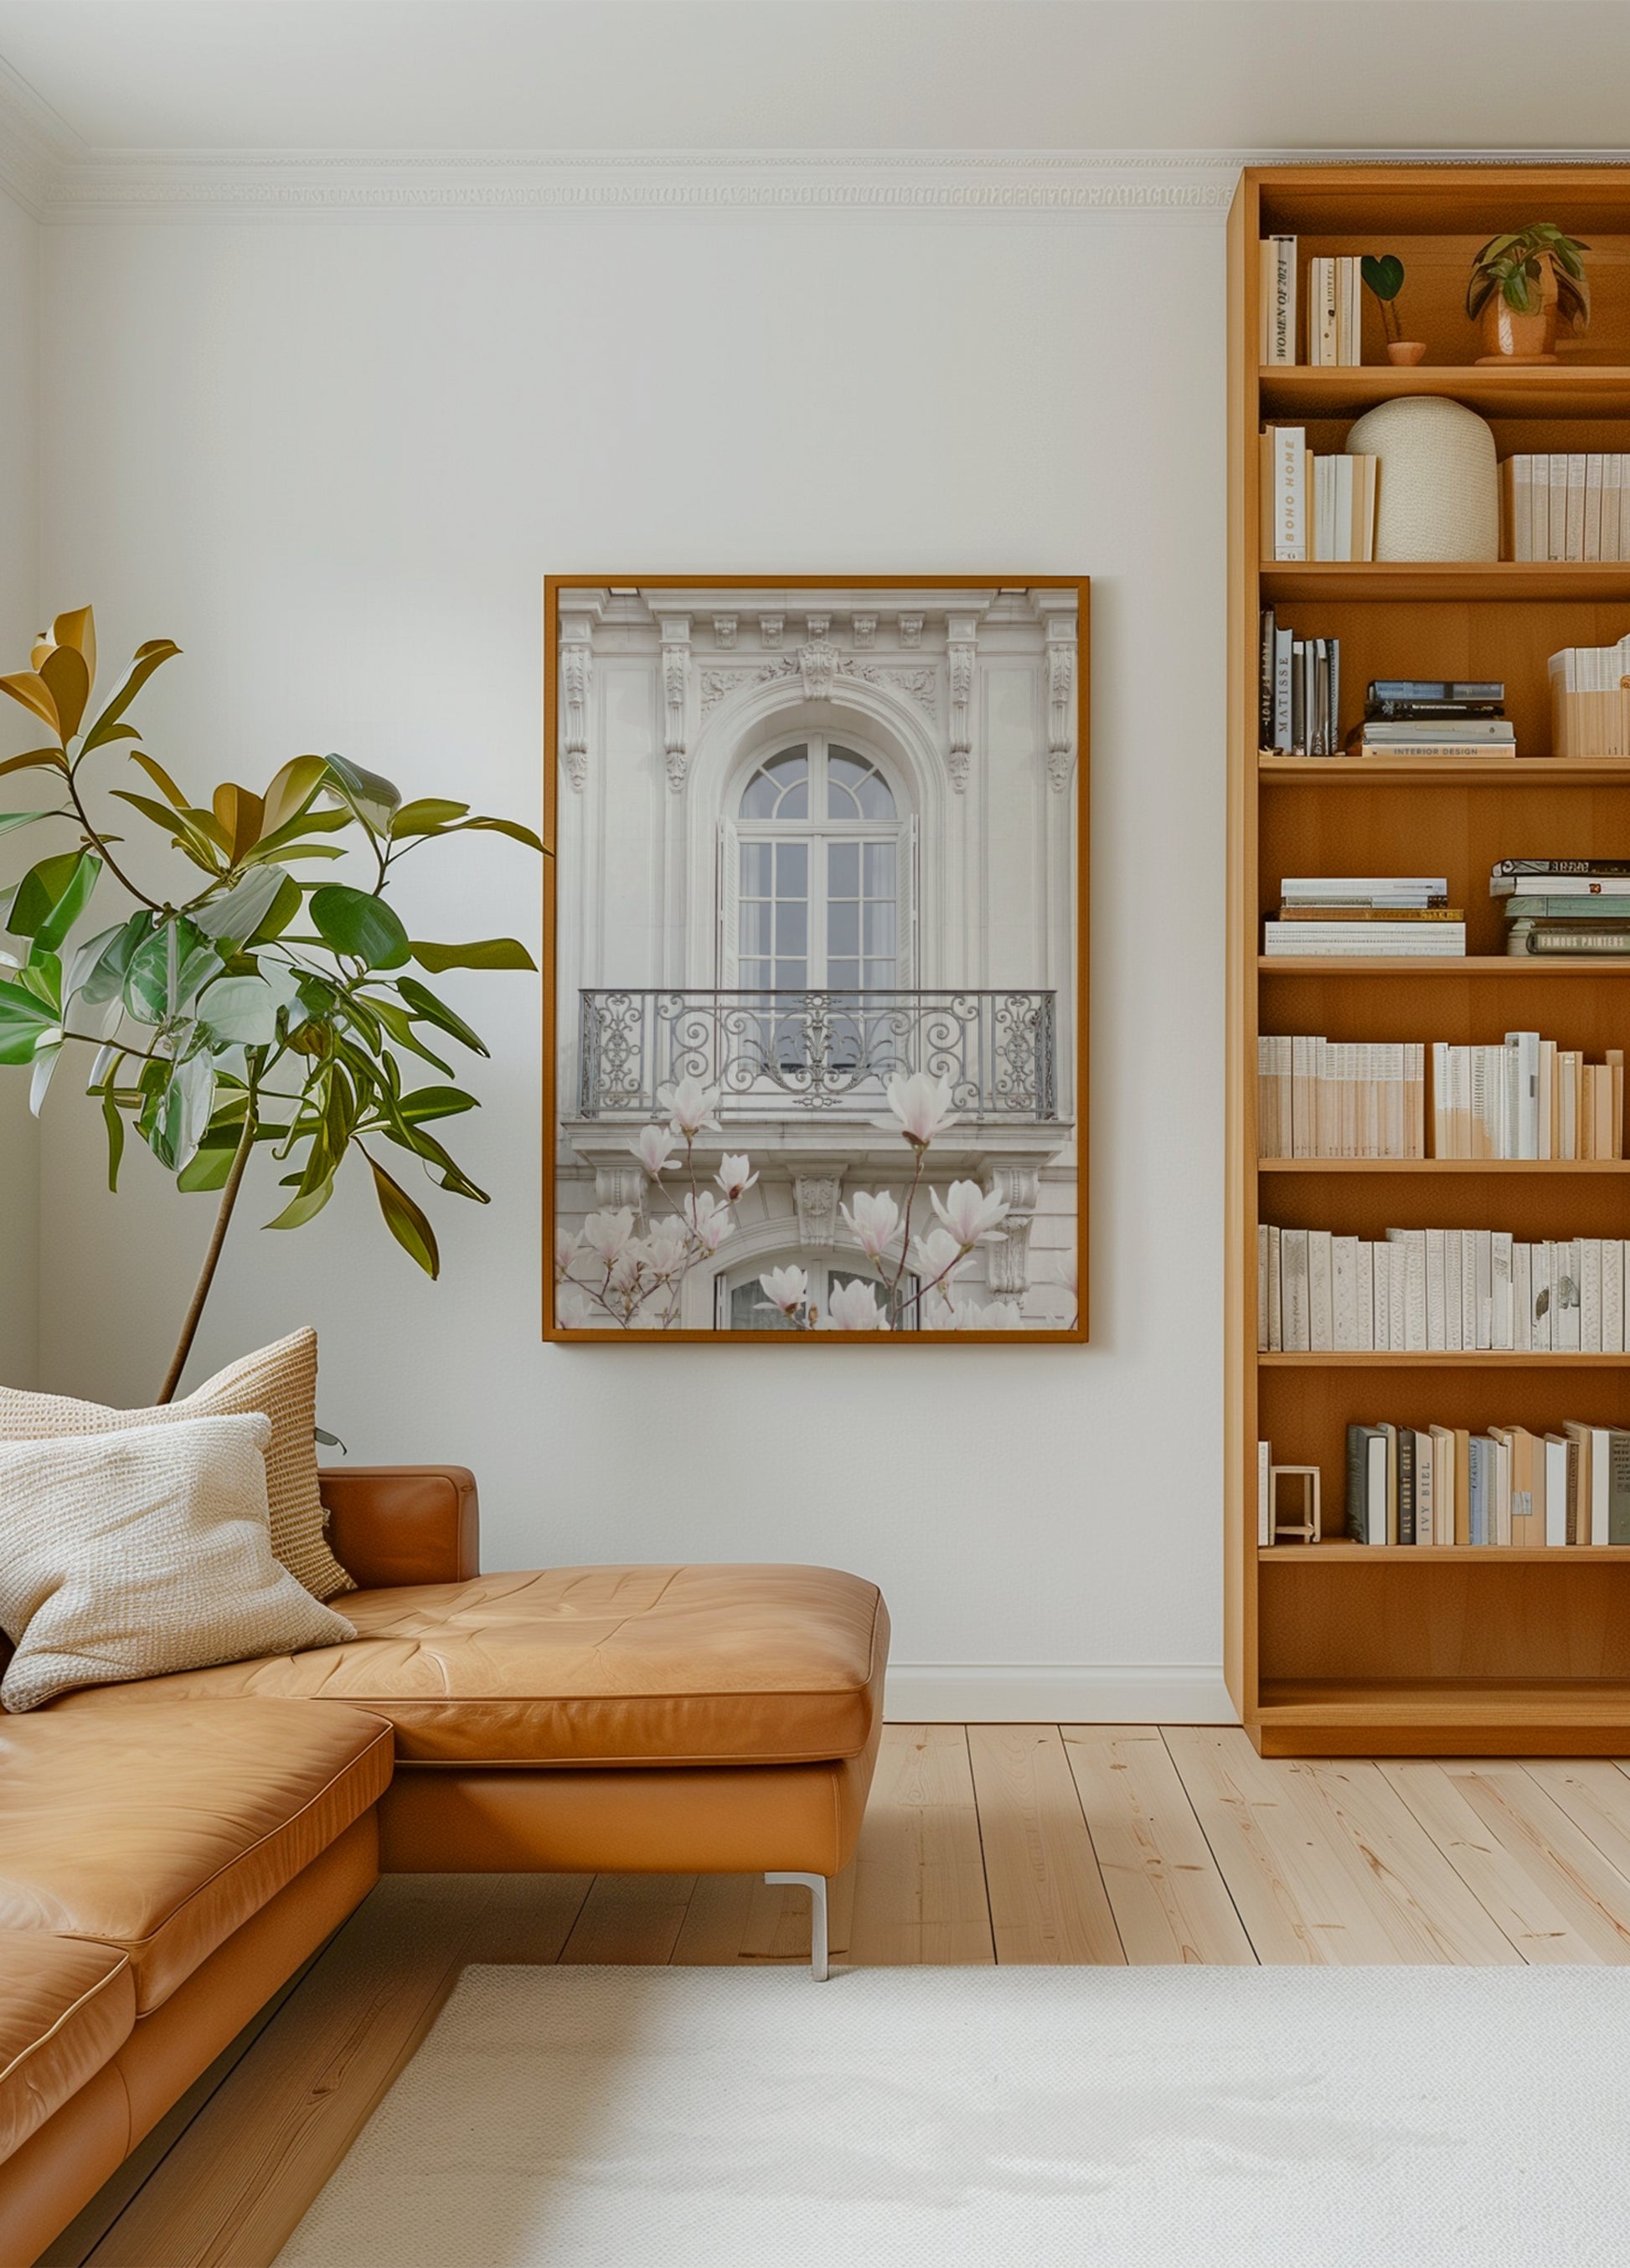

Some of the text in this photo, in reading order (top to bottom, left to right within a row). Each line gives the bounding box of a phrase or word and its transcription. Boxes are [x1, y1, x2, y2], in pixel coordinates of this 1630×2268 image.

[1277, 289, 1287, 305] OF
[1277, 308, 1287, 358] WOMEN
[1285, 441, 1295, 542] BOHO HOME
[1278, 657, 1288, 733] MATISSE
[1541, 937, 1625, 947] FAMOUS PAINTERS
[1402, 1445, 1412, 1534] ALL ABOUT CATS
[1421, 1462, 1431, 1532] IVY BIEL
